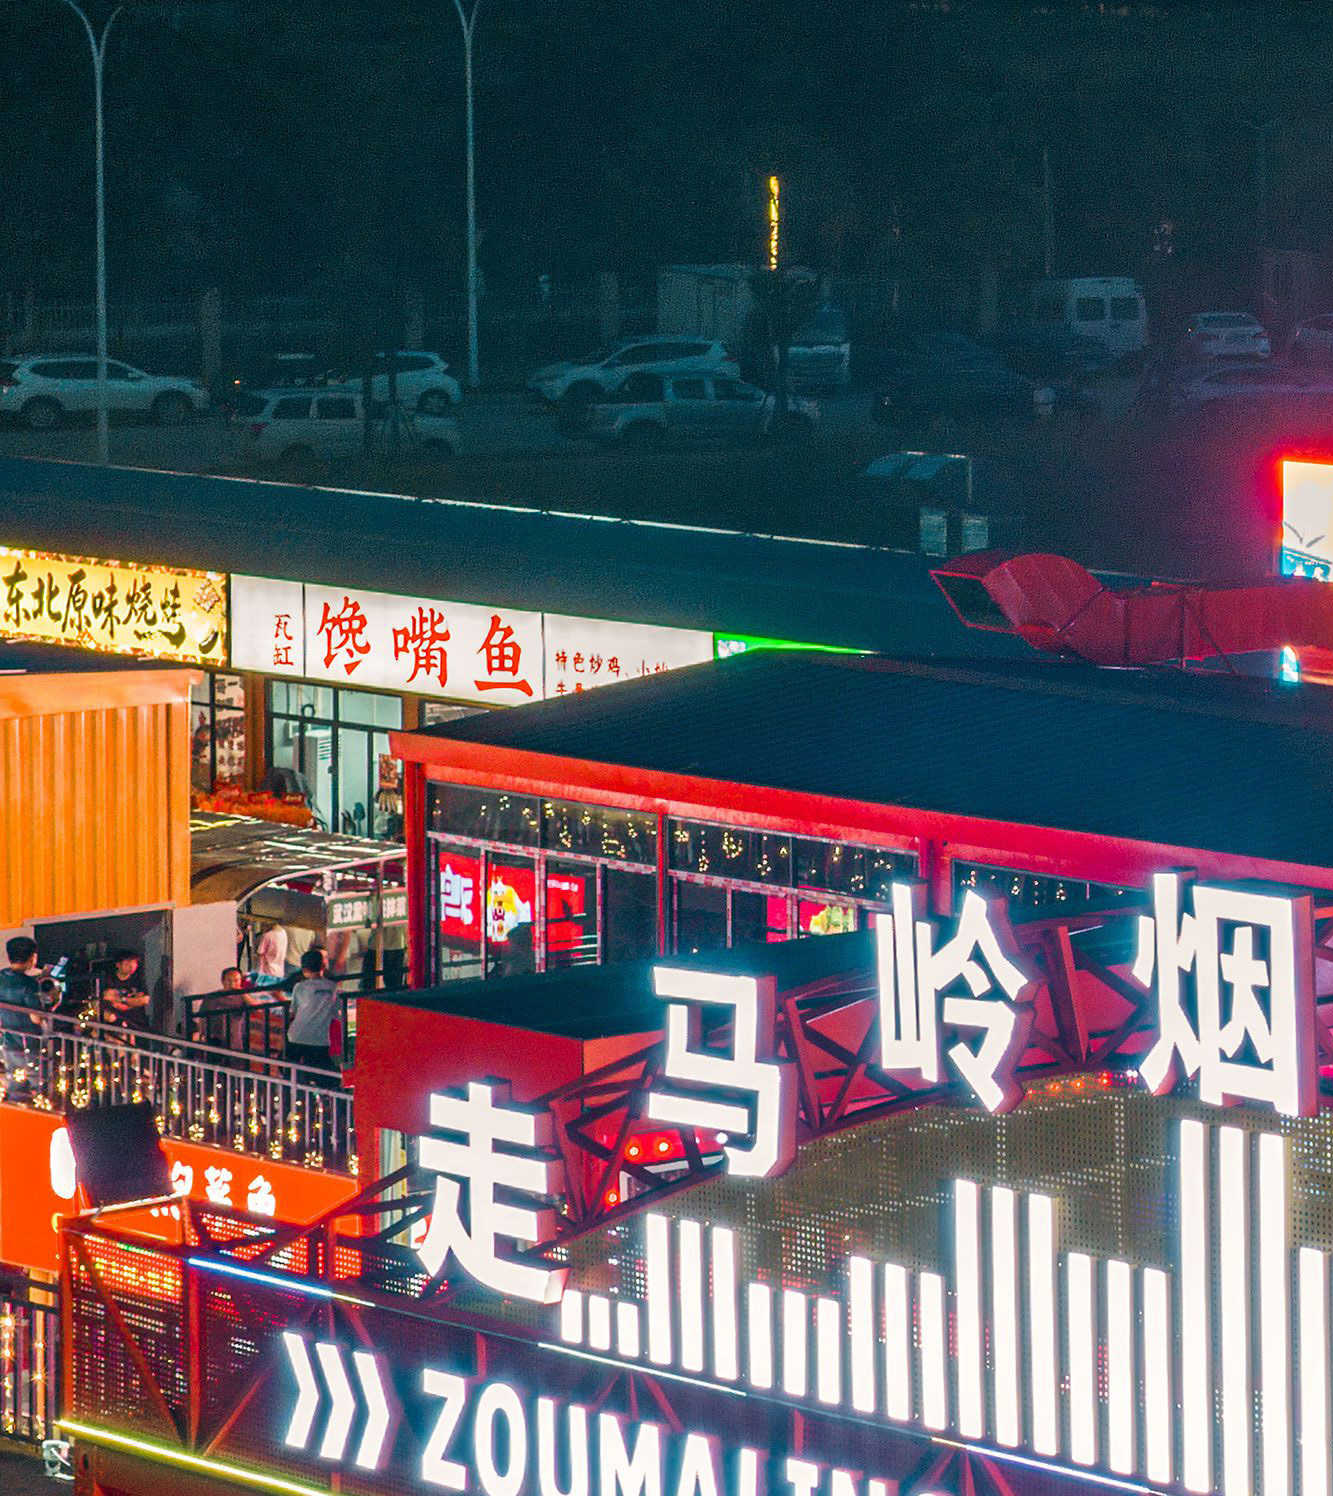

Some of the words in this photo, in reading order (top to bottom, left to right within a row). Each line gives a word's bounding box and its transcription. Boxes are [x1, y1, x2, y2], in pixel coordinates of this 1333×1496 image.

[273, 614, 294, 666] 瓦缸
[317, 596, 534, 697] 馋嘴鱼
